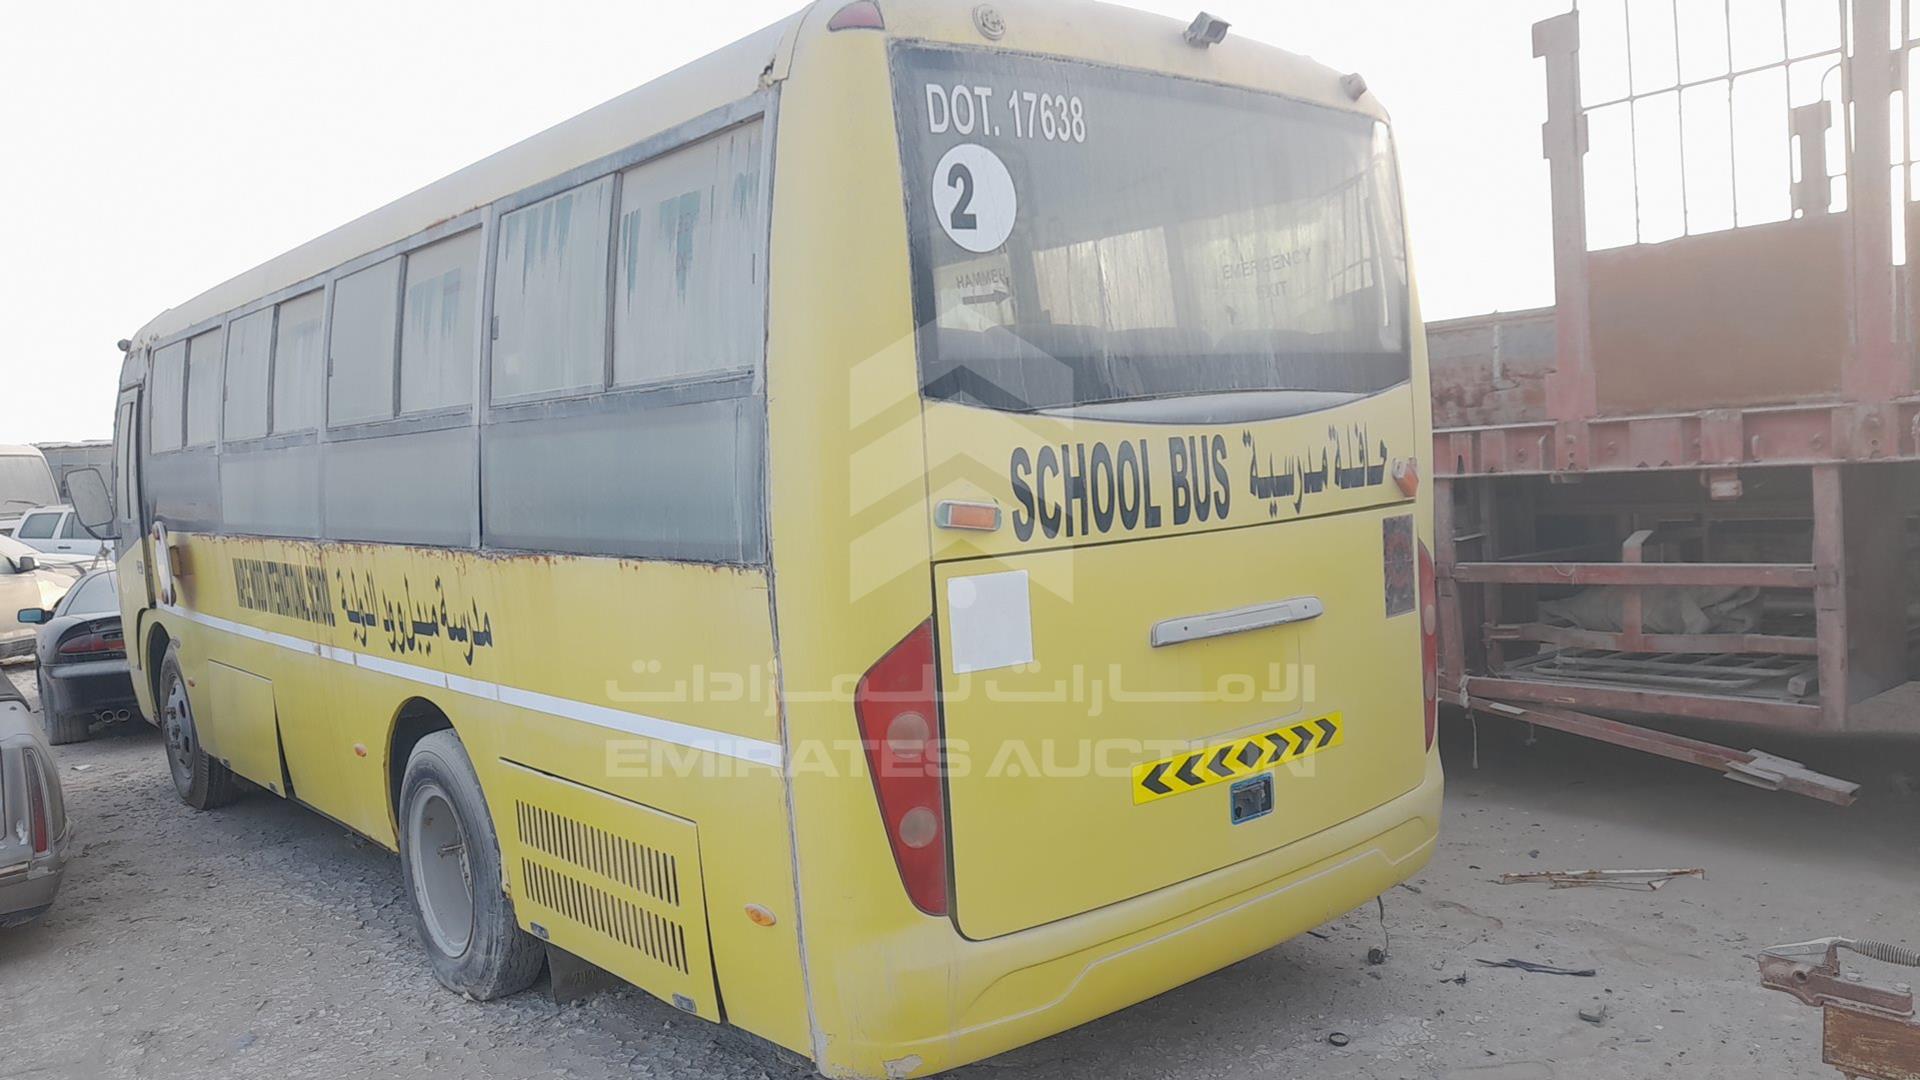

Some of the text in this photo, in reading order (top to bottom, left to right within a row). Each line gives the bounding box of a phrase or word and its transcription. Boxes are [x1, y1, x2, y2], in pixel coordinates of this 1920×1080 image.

[925, 83, 1086, 143] DOT. 17638
[947, 162, 978, 230] 2
[1010, 433, 1231, 543] SCHOOL BUS
[1242, 420, 1388, 519] حافلة مدرسية
[336, 566, 381, 648] الدولية
[434, 574, 493, 667] مدرسة
